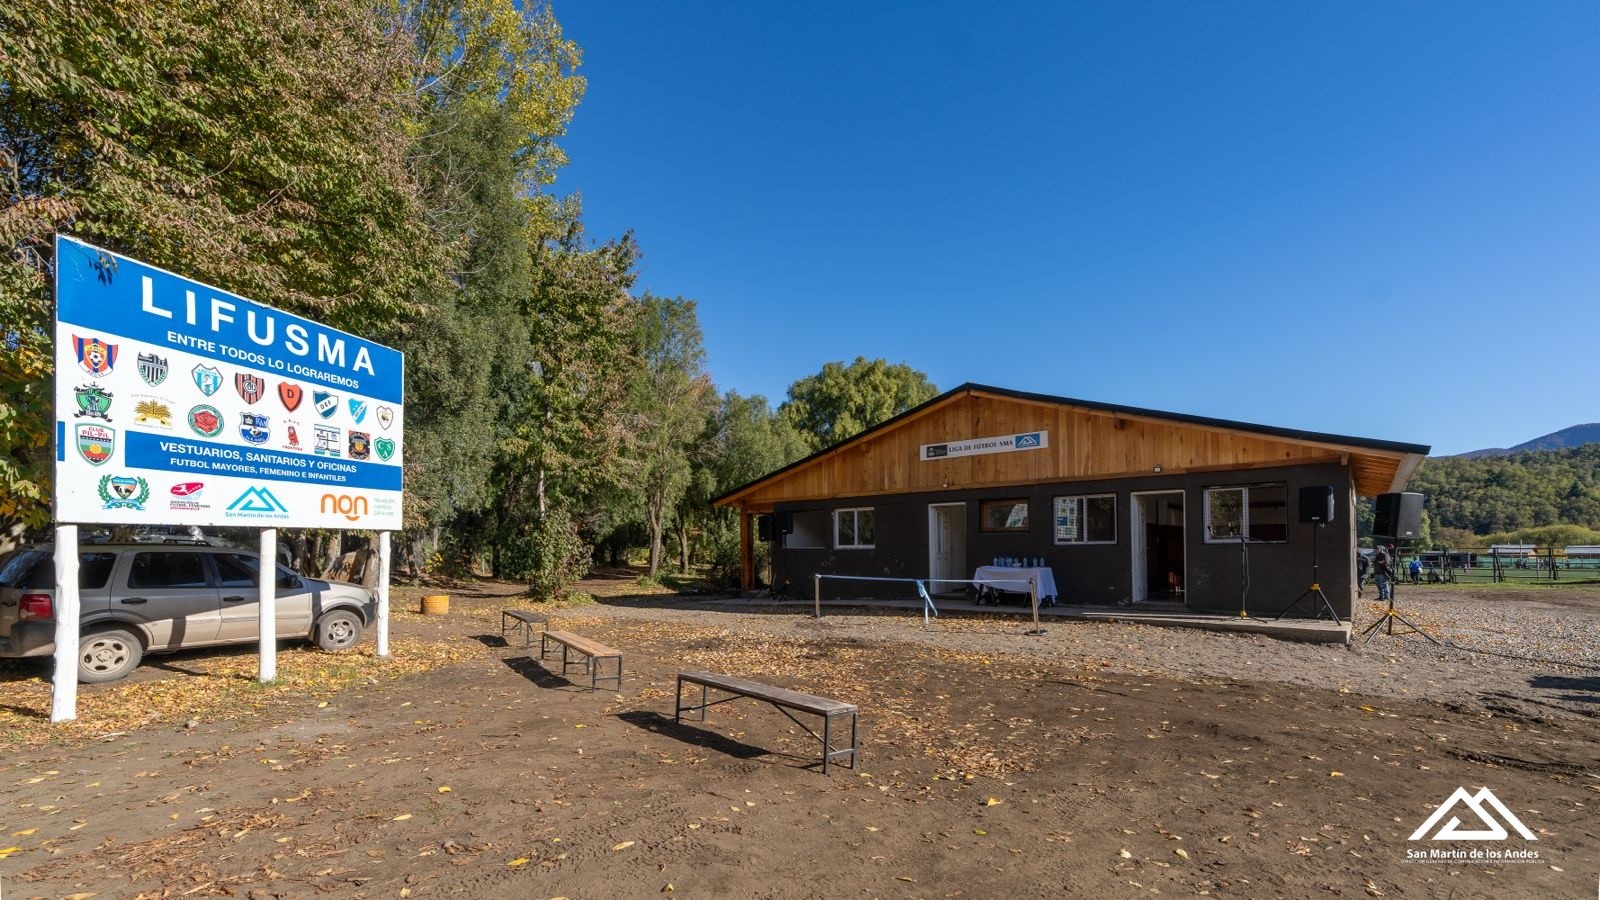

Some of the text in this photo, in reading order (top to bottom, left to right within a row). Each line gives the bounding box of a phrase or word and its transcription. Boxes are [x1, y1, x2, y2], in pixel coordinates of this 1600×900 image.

[142, 276, 375, 376] LIFUSMA
[167, 330, 359, 389] ENTRE TODOS LO LOGRAREMOS
[160, 441, 357, 473] VESTUARIOS, SANITARIOS Y OFICINAS
[948, 445, 963, 453] LIGA
[170, 457, 210, 469] FUTBOL
[211, 462, 257, 474] MAYORES,
[259, 467, 301, 478] FEMENINO
[308, 472, 346, 482] INFANTILES
